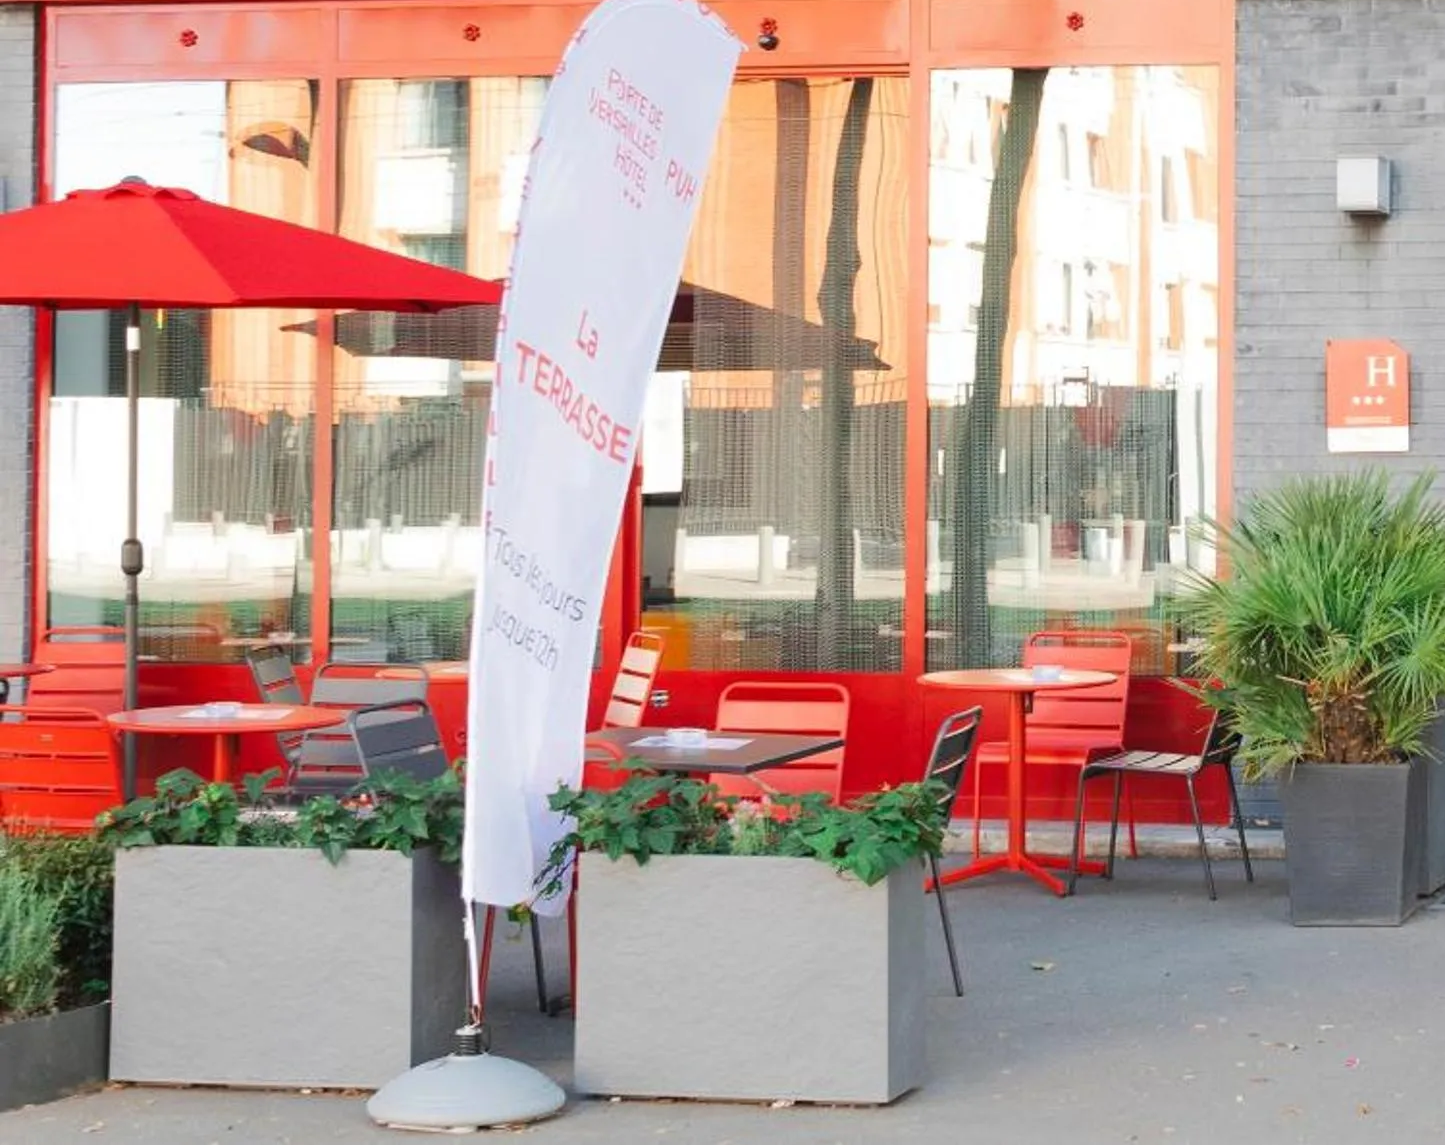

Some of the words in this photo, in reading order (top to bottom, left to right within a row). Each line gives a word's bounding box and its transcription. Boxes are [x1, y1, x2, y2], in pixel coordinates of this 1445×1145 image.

[576, 310, 599, 359] La
[1367, 355, 1396, 388] H
[515, 341, 632, 464] TERRASSE
